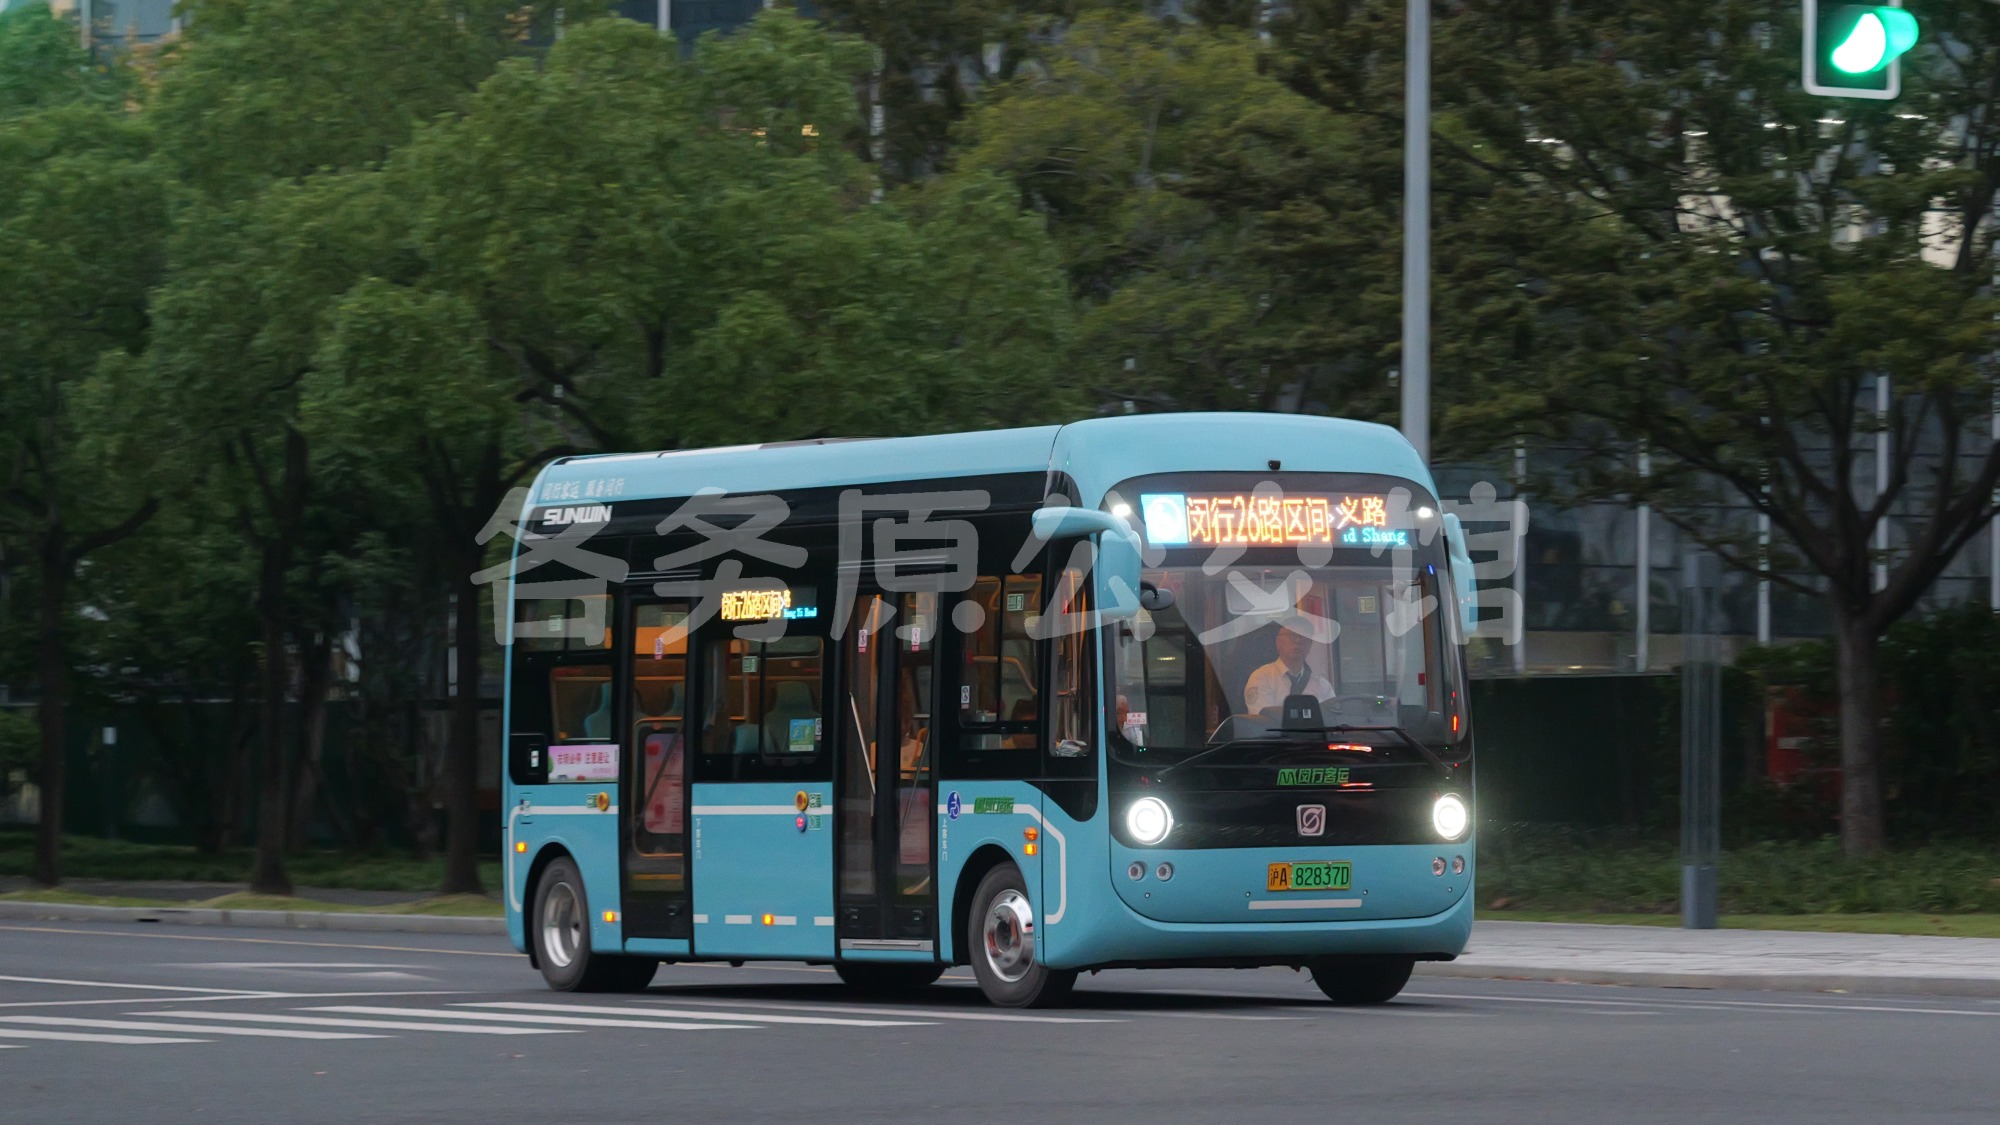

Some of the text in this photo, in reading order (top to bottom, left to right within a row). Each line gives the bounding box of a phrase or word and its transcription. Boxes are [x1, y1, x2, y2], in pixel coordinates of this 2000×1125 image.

[542, 505, 613, 526] SUNWIN
[1186, 496, 1331, 544] 闵行26路区间
[721, 590, 782, 620] 闵行26路区间
[1298, 767, 1350, 784] 闵行客运
[1295, 866, 1350, 886] 82837D
